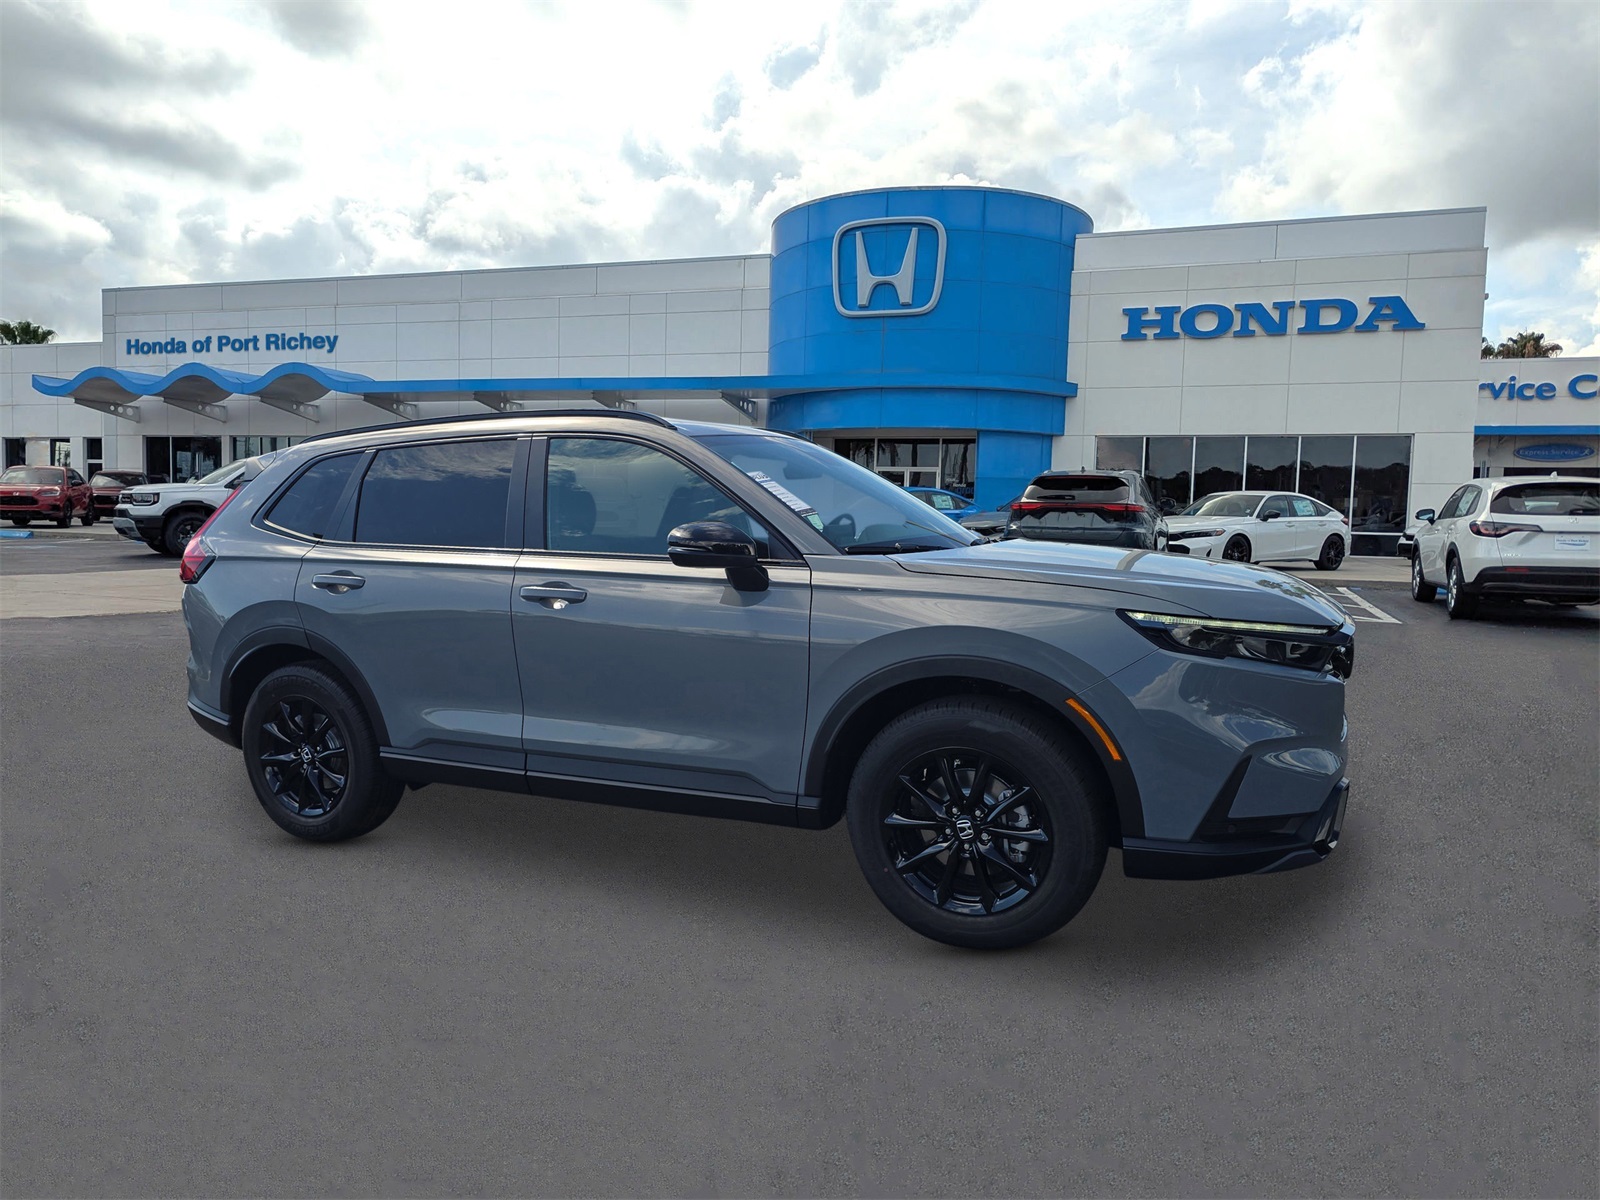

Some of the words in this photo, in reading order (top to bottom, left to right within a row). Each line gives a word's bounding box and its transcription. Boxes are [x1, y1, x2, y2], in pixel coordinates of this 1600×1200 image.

[1121, 295, 1426, 341] HONDA
[126, 337, 187, 355] Honda
[191, 335, 212, 353] of
[217, 334, 260, 352] Port
[265, 332, 339, 354] Richey
[1567, 373, 1600, 400] C
[1519, 448, 1549, 457] Express
[1550, 448, 1580, 456] Service
